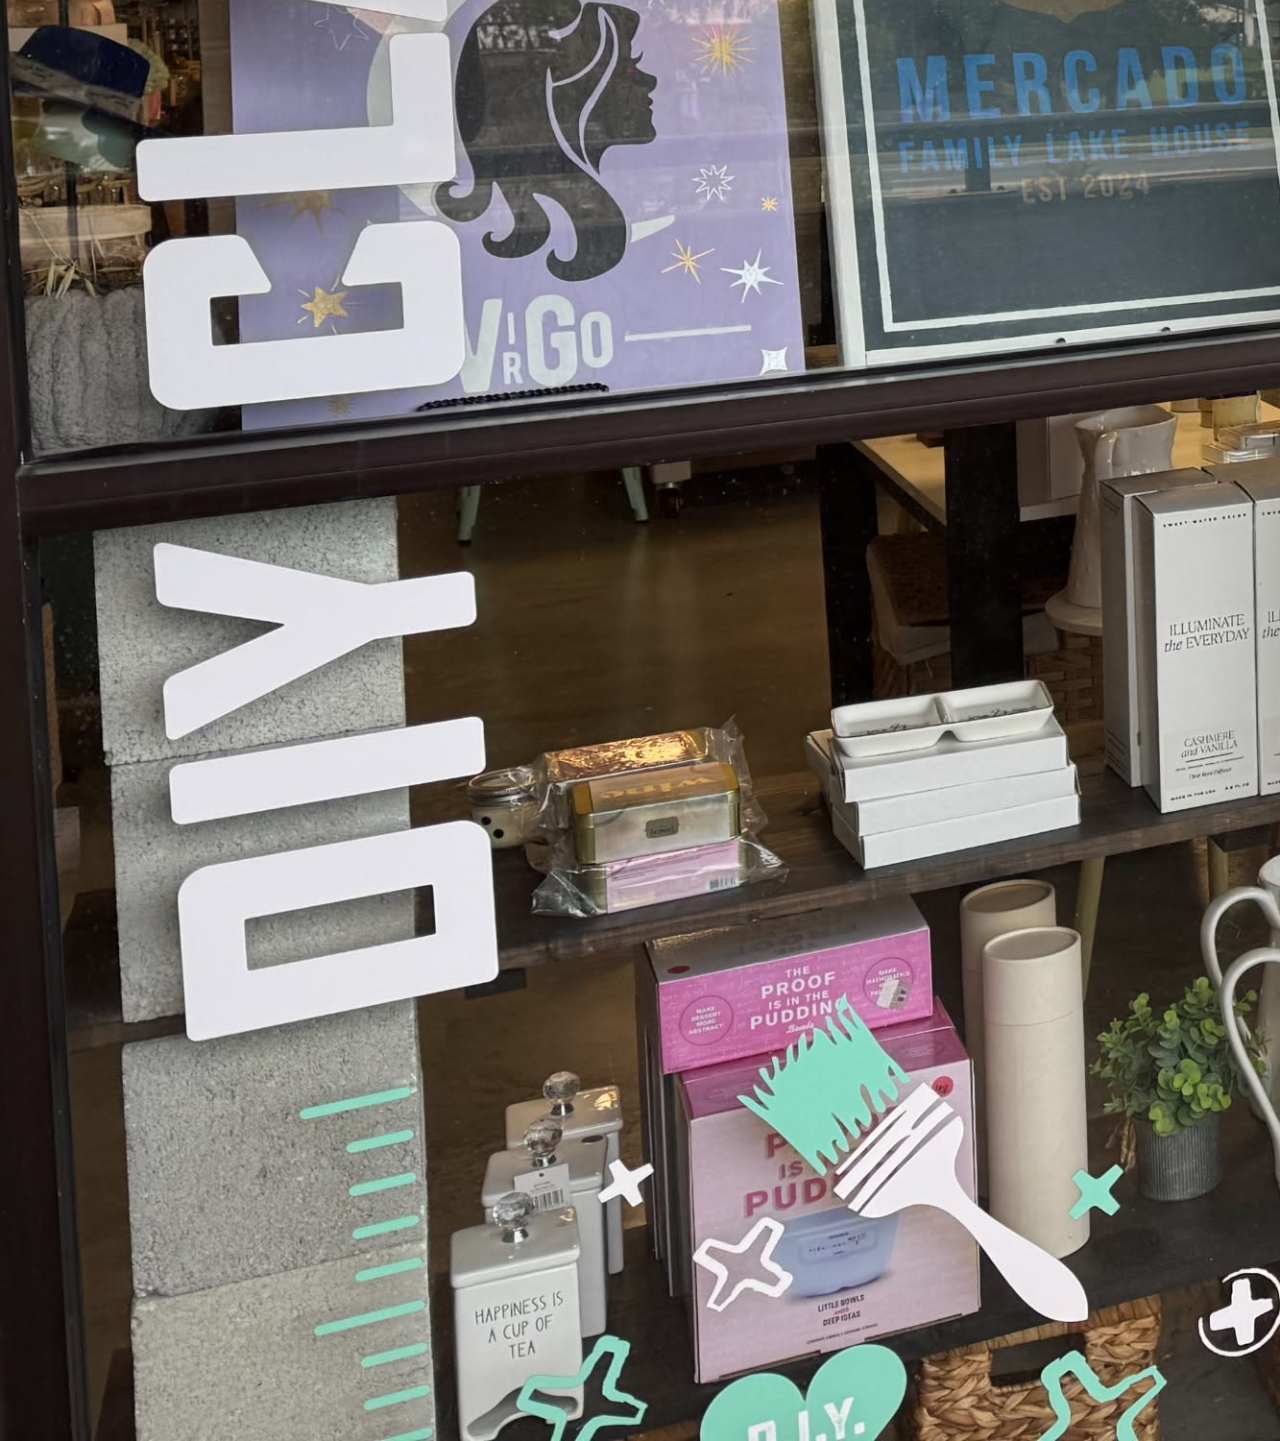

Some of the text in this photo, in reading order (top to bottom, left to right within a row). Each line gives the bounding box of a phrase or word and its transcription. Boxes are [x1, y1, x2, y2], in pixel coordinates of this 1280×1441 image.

[896, 43, 1249, 125] MERCADO
[899, 120, 1251, 172] FAMILY LAKE HOUSE
[1020, 175, 1069, 204] EST
[1169, 612, 1246, 638] ILLUMINATE
[1261, 628, 1280, 640] the
[1163, 626, 1250, 653] the EVERYDAY
[1180, 738, 1239, 759] and VANILLA
[1183, 729, 1236, 748] CASHMERE
[152, 541, 500, 1042] DIY
[784, 965, 810, 978] THE
[760, 971, 837, 1000] PROOF
[768, 989, 830, 1011] IS IN THE
[474, 1290, 564, 1325] HAPPINESS IS
[487, 1313, 553, 1344] A CUP OF
[508, 1341, 537, 1360] TEA
